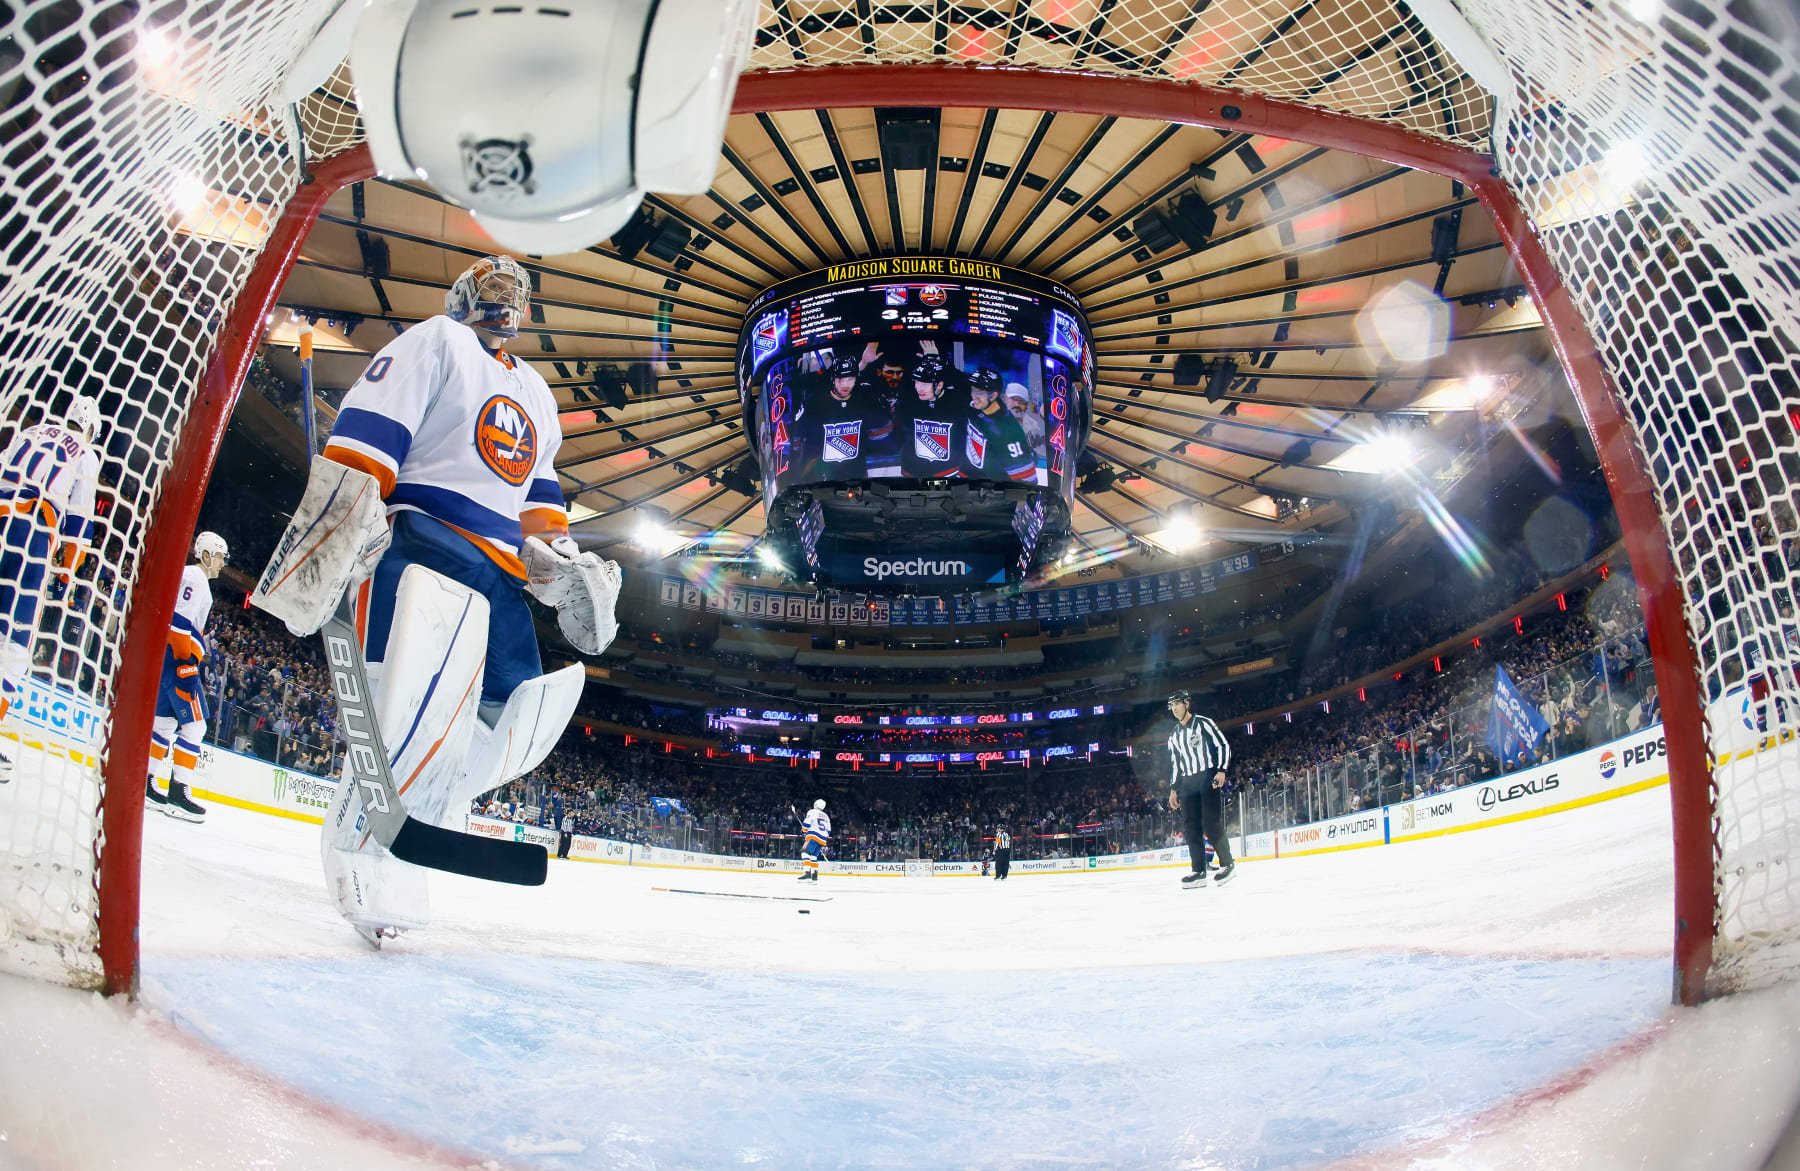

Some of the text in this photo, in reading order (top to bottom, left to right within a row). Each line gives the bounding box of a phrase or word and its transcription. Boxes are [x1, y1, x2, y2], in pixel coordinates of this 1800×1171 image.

[828, 258, 1001, 282] MADISON SQUARE GARDEN
[881, 309, 899, 320] 3
[932, 309, 949, 319] 2
[358, 356, 394, 386] 0
[494, 401, 528, 445] NY
[770, 373, 790, 477] GOAL
[916, 423, 947, 433] NEW YORK
[1049, 374, 1067, 477] GOAL
[827, 425, 858, 436] NEW YORK
[831, 436, 855, 456] RANGERS
[920, 433, 945, 458] RANGERS
[1007, 442, 1023, 458] 91
[485, 439, 530, 476] ISLANDERS
[1280, 540, 1295, 555] 13
[863, 557, 966, 581] Spectrum
[1235, 555, 1249, 570] 99
[183, 587, 193, 600] 6
[667, 587, 673, 600] 1
[688, 591, 697, 604] 2
[733, 597, 742, 610] 7
[752, 600, 761, 612] 9
[771, 602, 780, 615] 9
[791, 604, 802, 616] 11
[811, 606, 821, 619] 11
[832, 607, 846, 619] 19
[852, 607, 867, 620] 30
[873, 608, 888, 621] 35
[762, 710, 791, 720] GOAL
[834, 715, 863, 724] GOAL
[978, 714, 1006, 724] GOAL
[1049, 709, 1077, 719] GOAL
[328, 635, 390, 814] BAUER
[906, 717, 934, 725] GOAL
[766, 747, 794, 757] GOAL
[835, 752, 864, 761] GOAL
[976, 752, 1004, 761] GOAL
[1045, 745, 1073, 756] GOAL
[1623, 740, 1667, 768] PEPS
[906, 754, 934, 762] GOAL
[289, 776, 336, 799] MONSTE
[1497, 773, 1560, 803] LEXUS
[1416, 802, 1453, 821] BETMGM
[1340, 818, 1377, 835] HYUNDAI
[518, 831, 555, 845] enterprise
